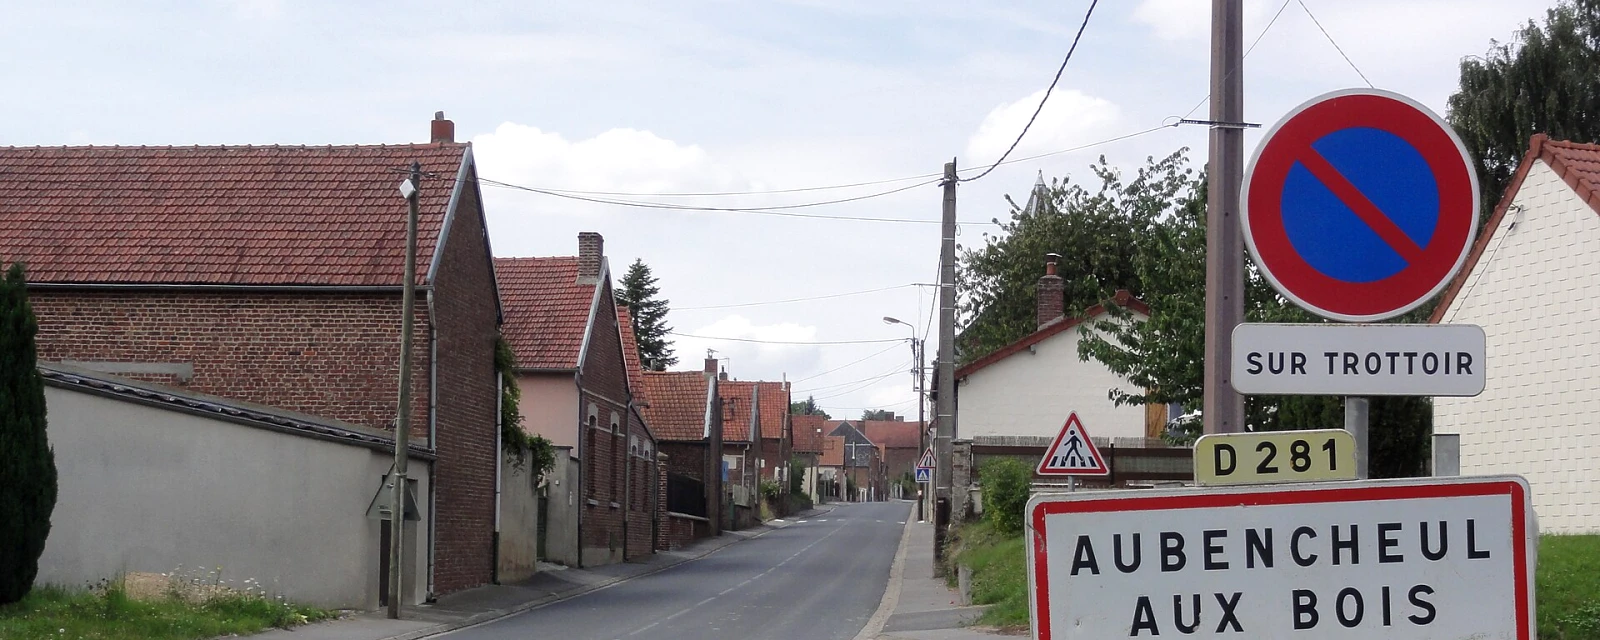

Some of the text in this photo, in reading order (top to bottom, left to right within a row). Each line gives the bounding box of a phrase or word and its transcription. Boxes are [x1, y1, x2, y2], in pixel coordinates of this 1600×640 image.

[1246, 351, 1473, 376] SUR TROTTOIR
[1213, 438, 1337, 477] D 281
[1070, 518, 1491, 576] AUBENCHEUL
[1130, 584, 1437, 637] AUX BOIS
